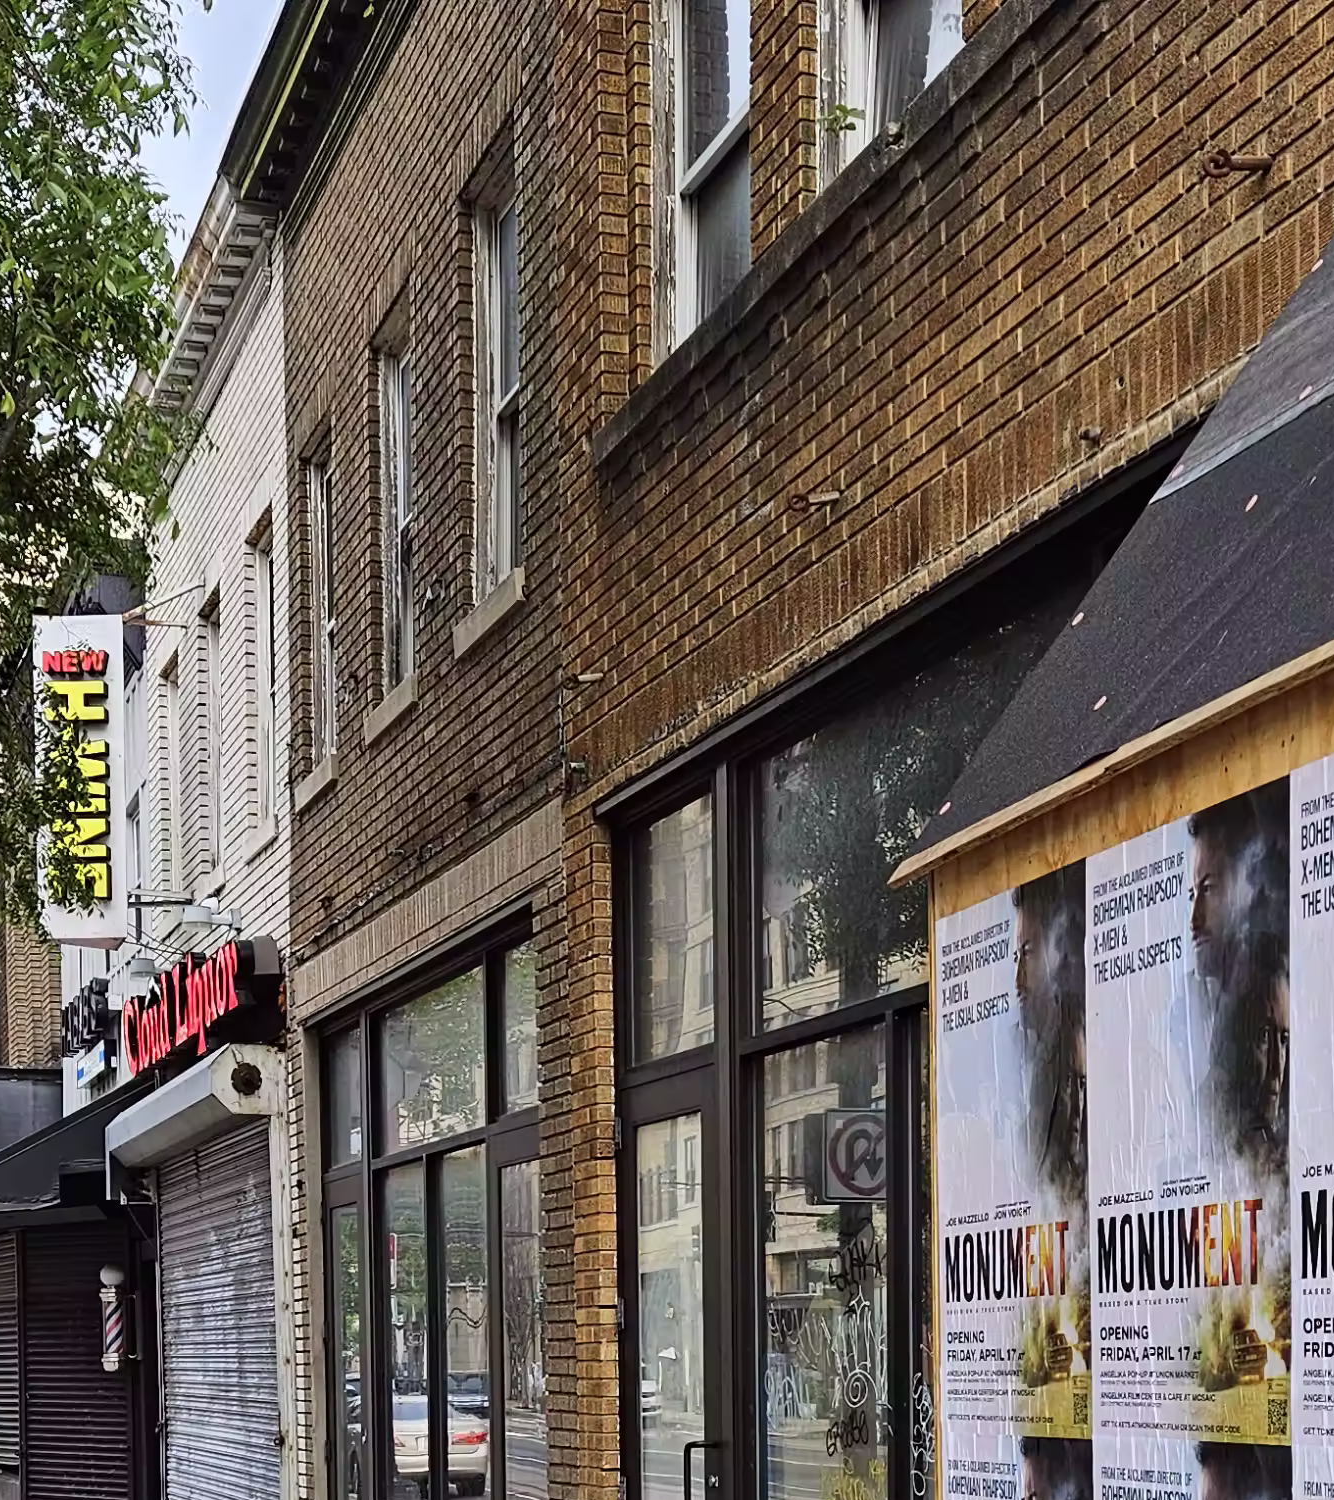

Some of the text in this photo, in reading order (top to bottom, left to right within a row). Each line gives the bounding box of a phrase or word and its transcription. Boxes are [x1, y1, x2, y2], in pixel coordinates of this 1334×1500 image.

[42, 651, 108, 674] NEW
[1093, 870, 1184, 928] BOHEMIAN RHAPSODY
[1301, 889, 1322, 921] THE
[123, 940, 239, 1078] Cloud Liquor
[1096, 1188, 1153, 1206] JOE MAZZELLO
[1159, 1181, 1211, 1199] JON VOIGHT
[945, 1220, 1070, 1304] MONUMENT
[1095, 1198, 1264, 1293] MONUMENT
